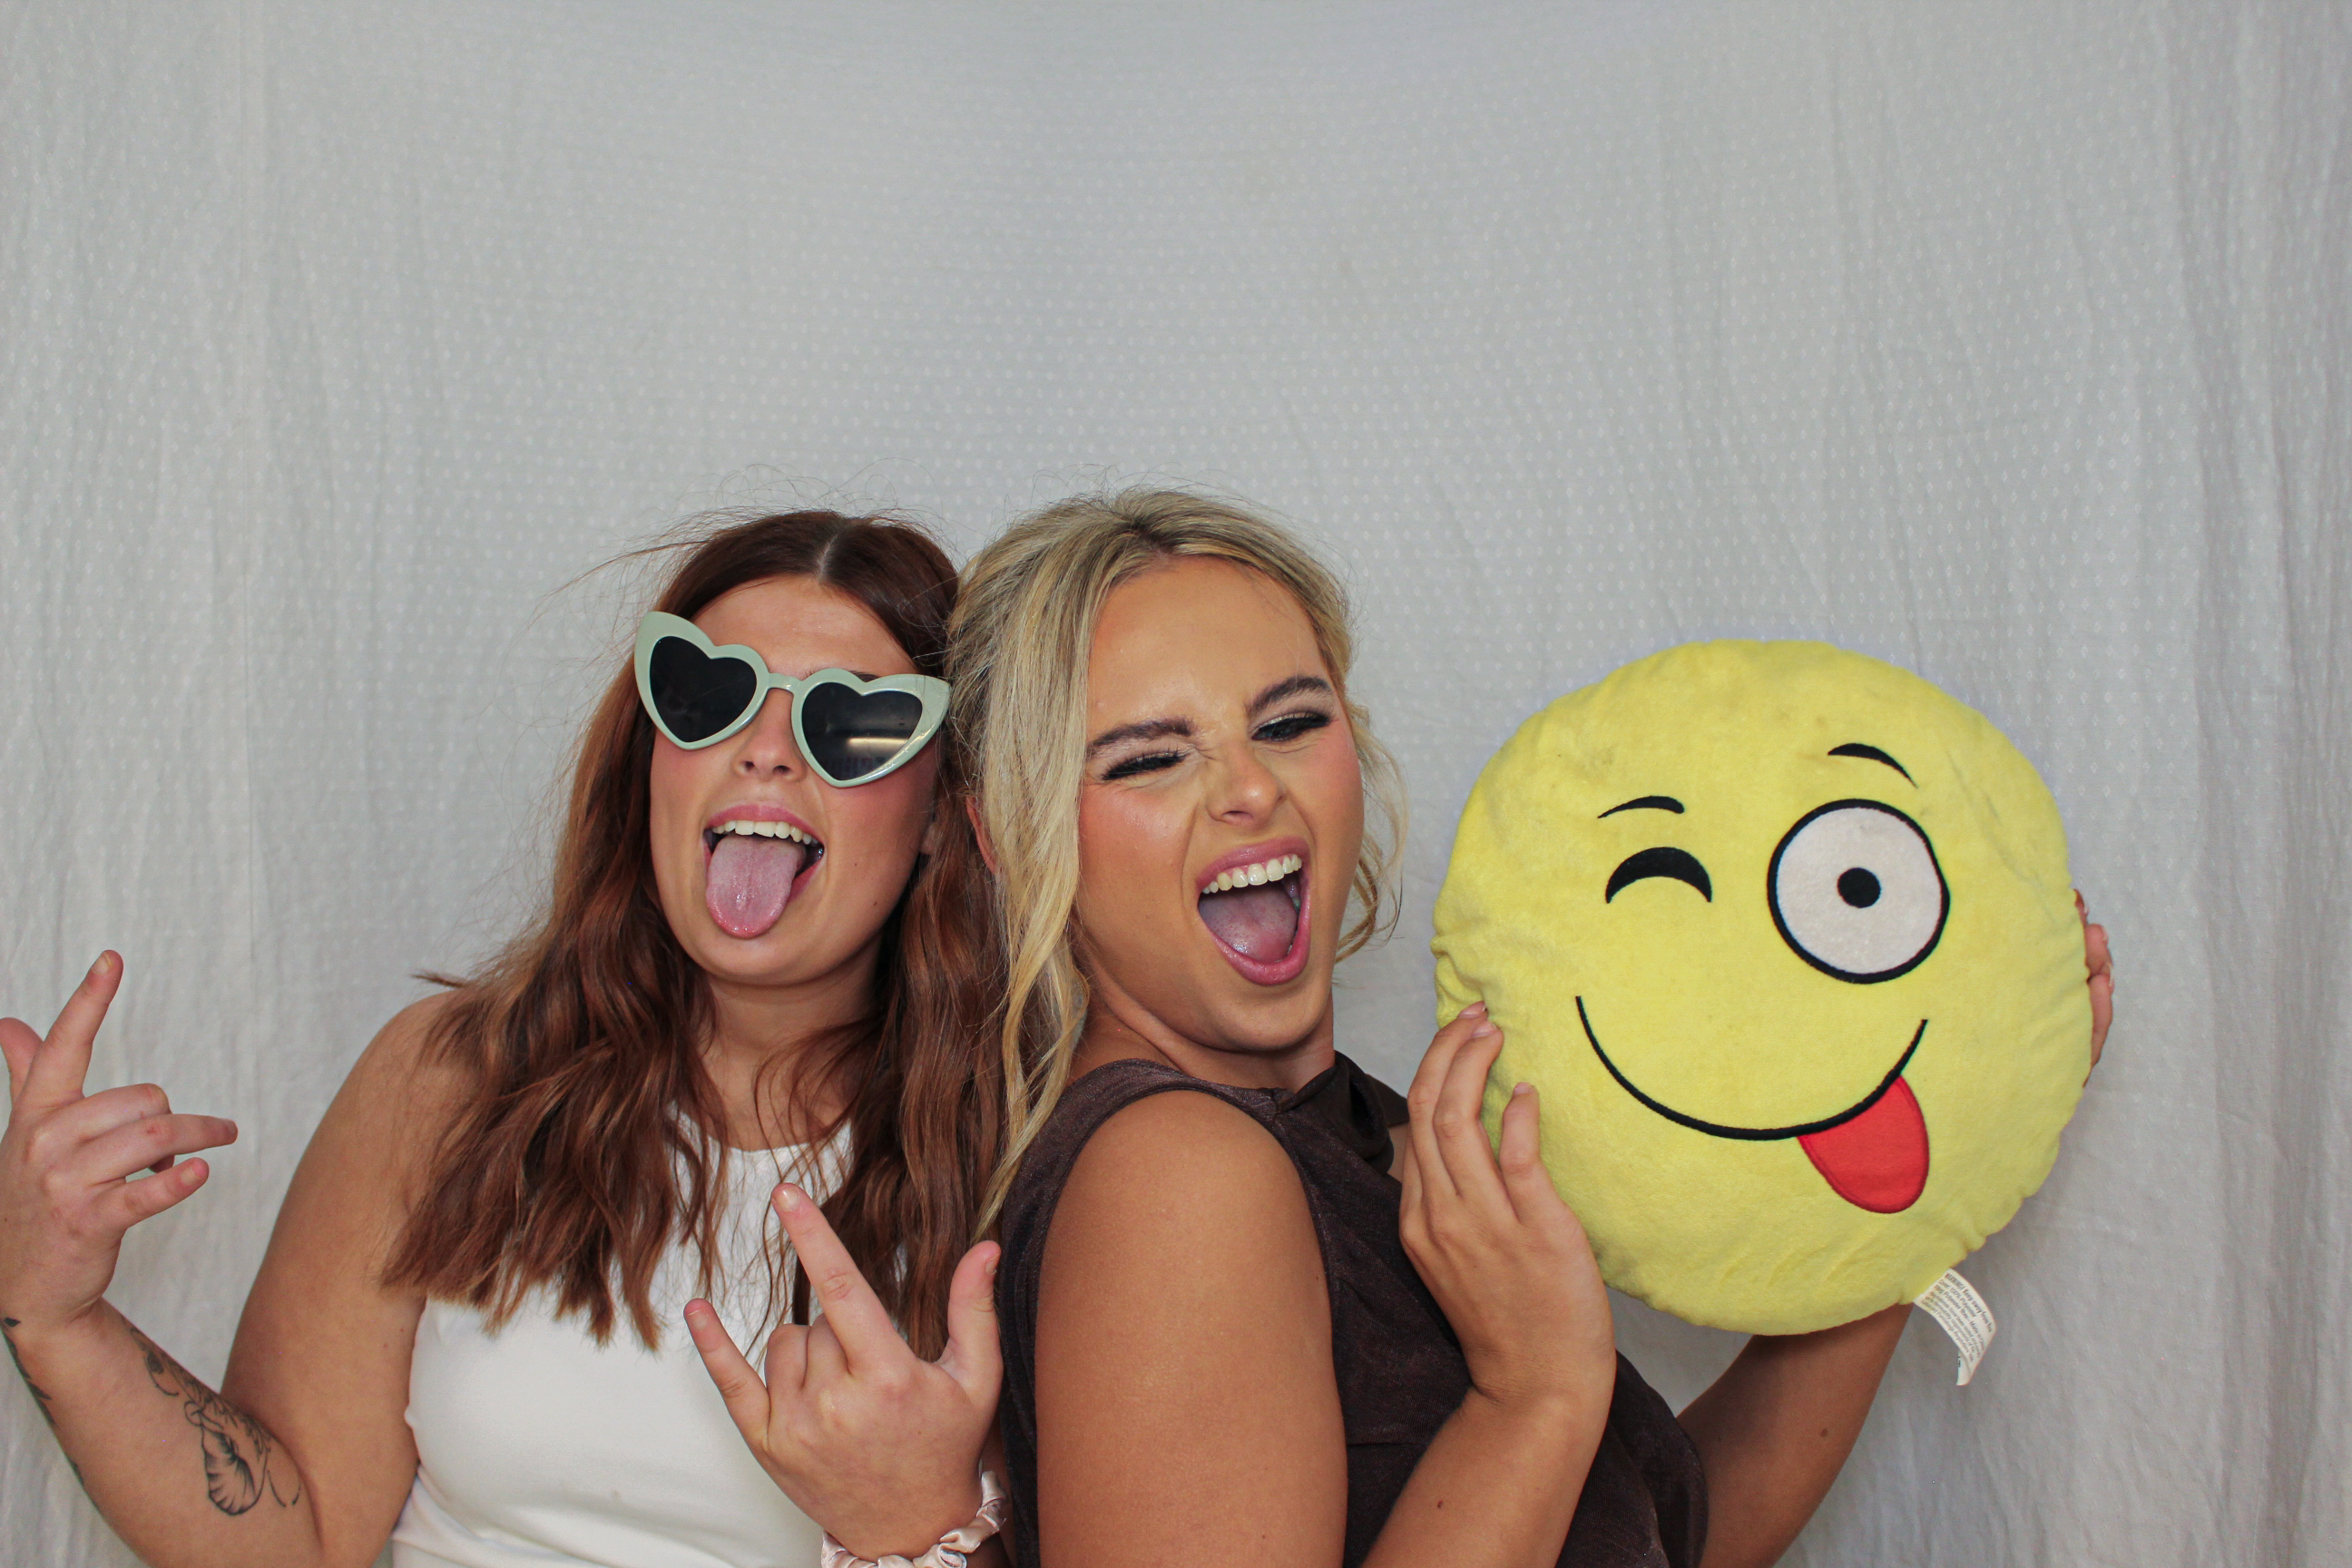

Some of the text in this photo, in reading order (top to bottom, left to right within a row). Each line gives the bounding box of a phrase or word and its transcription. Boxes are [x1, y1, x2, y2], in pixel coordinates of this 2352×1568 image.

[1942, 1290, 1963, 1311] Polyester
[1968, 1319, 1980, 1335] Made
[1958, 1297, 1978, 1318] Polyester
[1961, 1288, 1975, 1302] Keep
[1970, 1299, 1984, 1315] away
[1980, 1310, 1992, 1325] from
